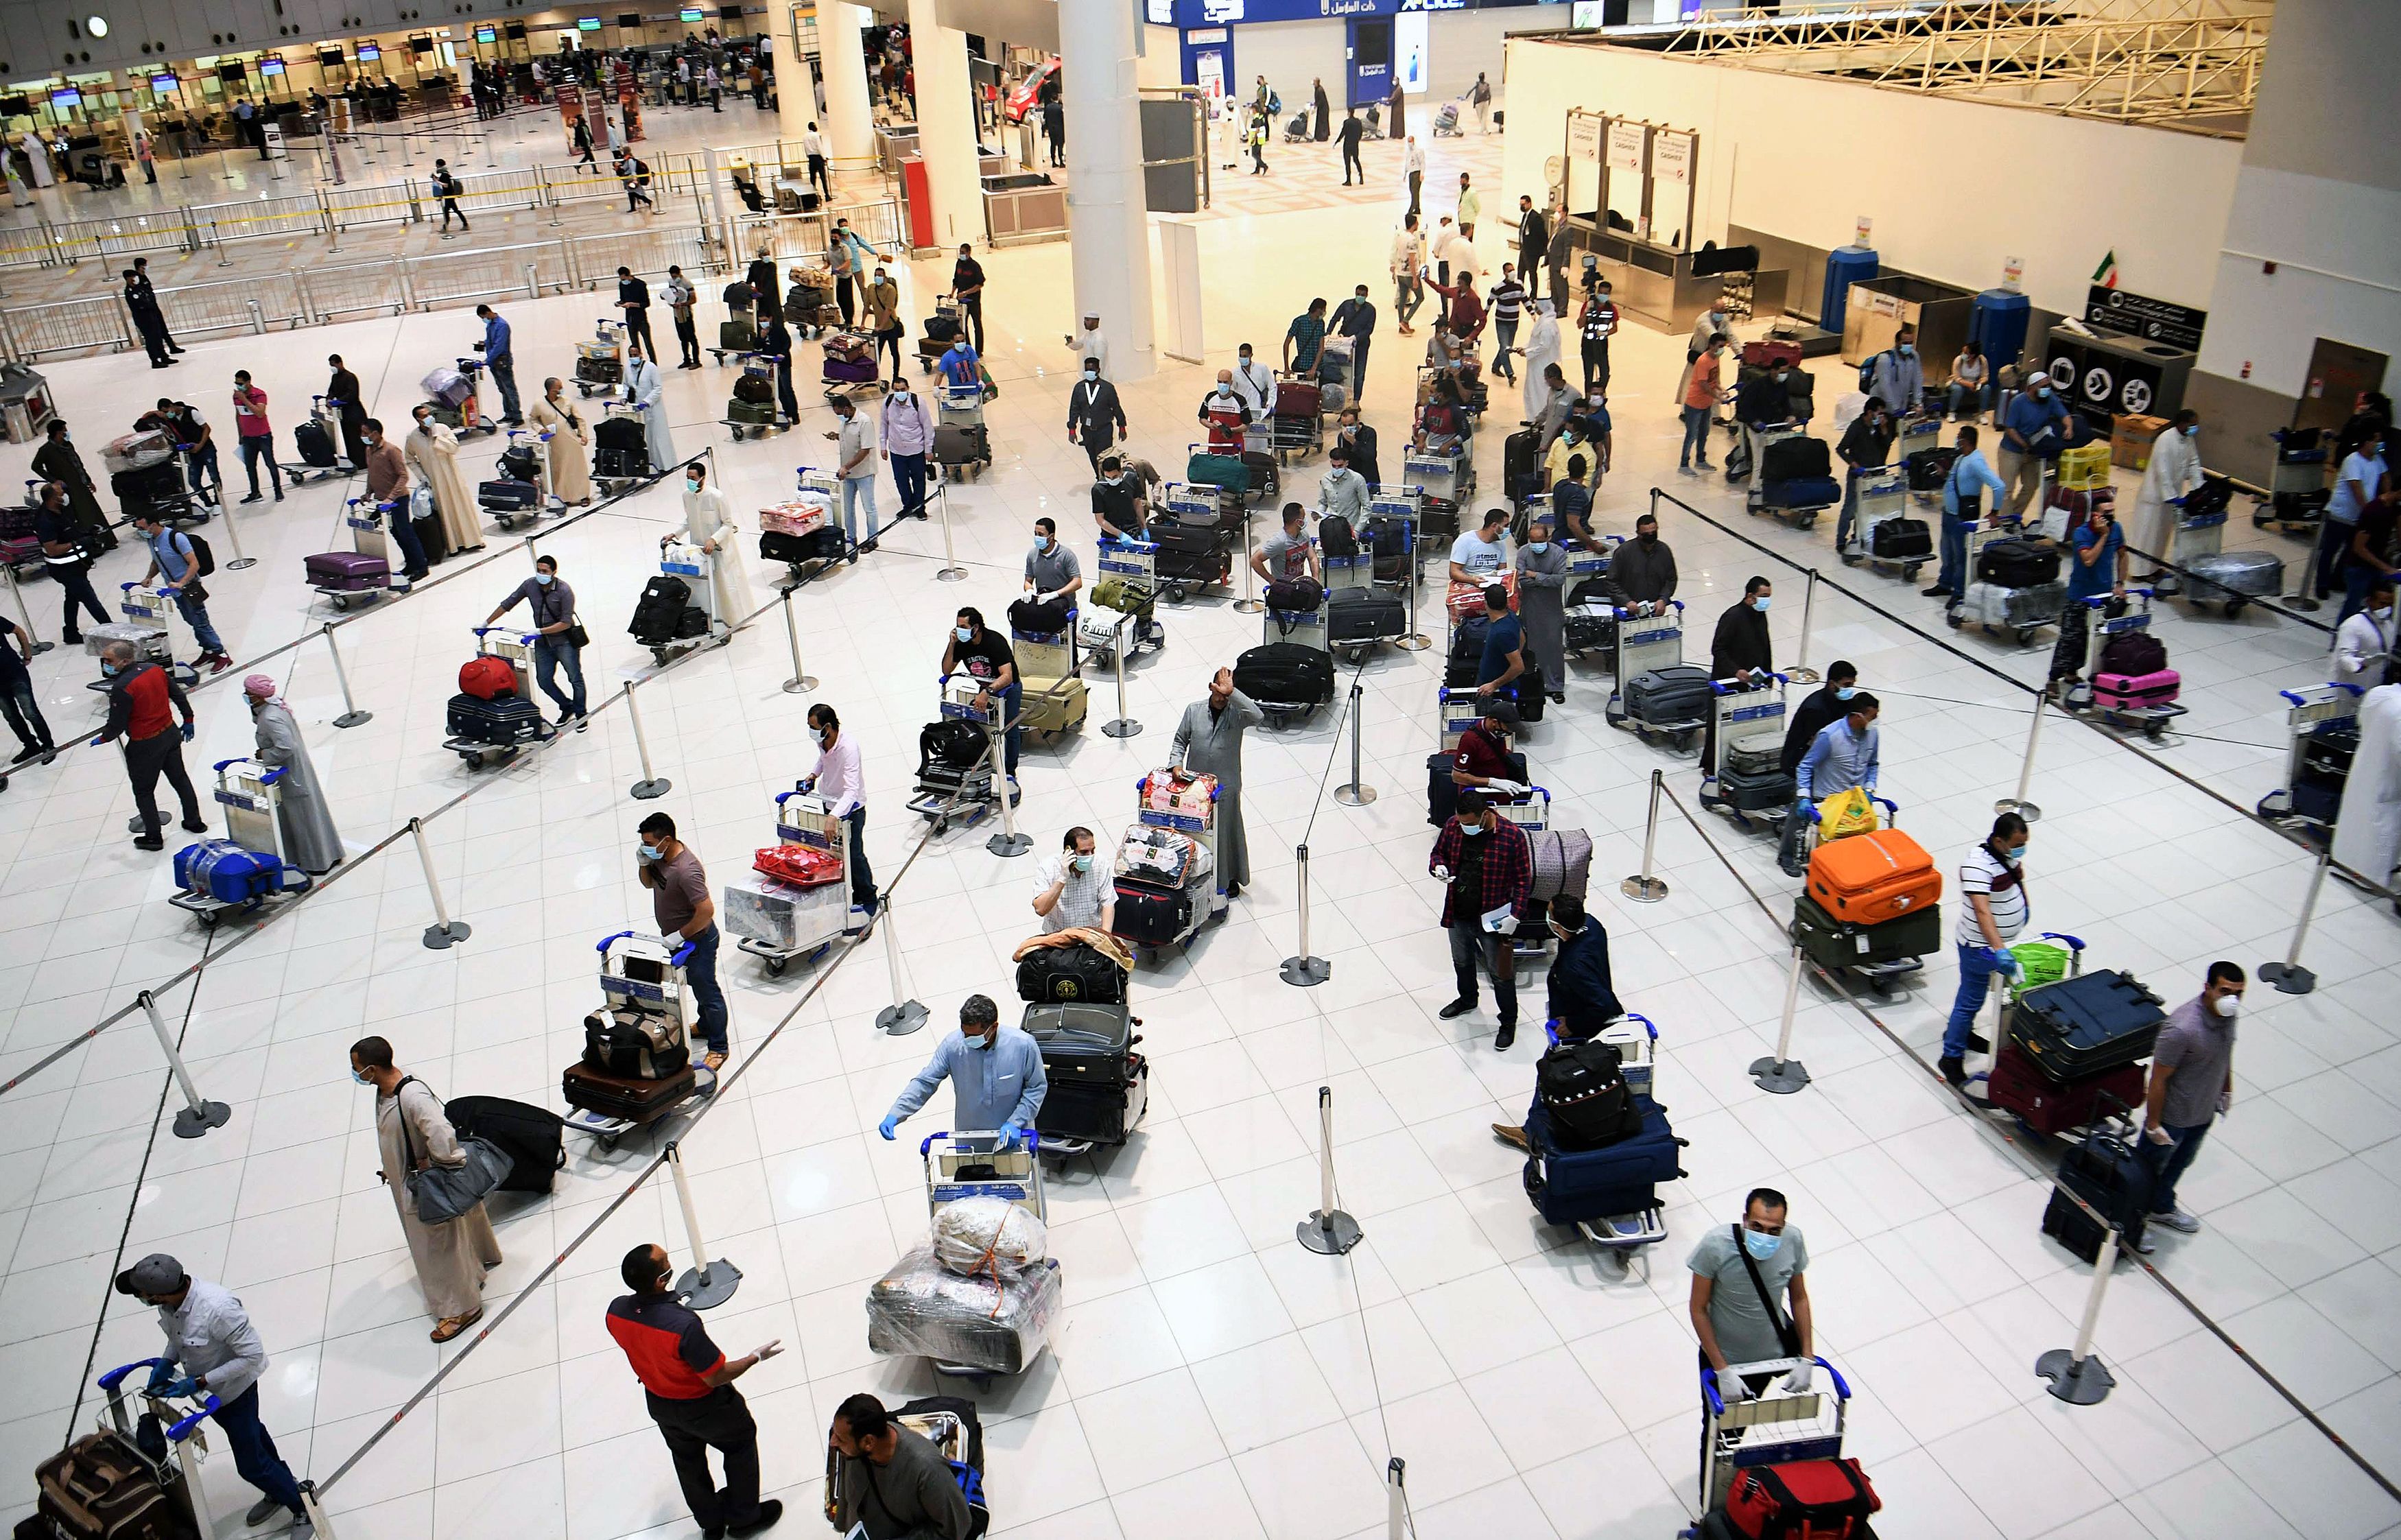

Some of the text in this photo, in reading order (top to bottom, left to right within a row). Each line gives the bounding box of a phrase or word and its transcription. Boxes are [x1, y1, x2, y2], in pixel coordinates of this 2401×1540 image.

[1615, 142, 1635, 151] CASHIER
[1660, 152, 1682, 161] CASHIER
[1459, 753, 1469, 764] 3
